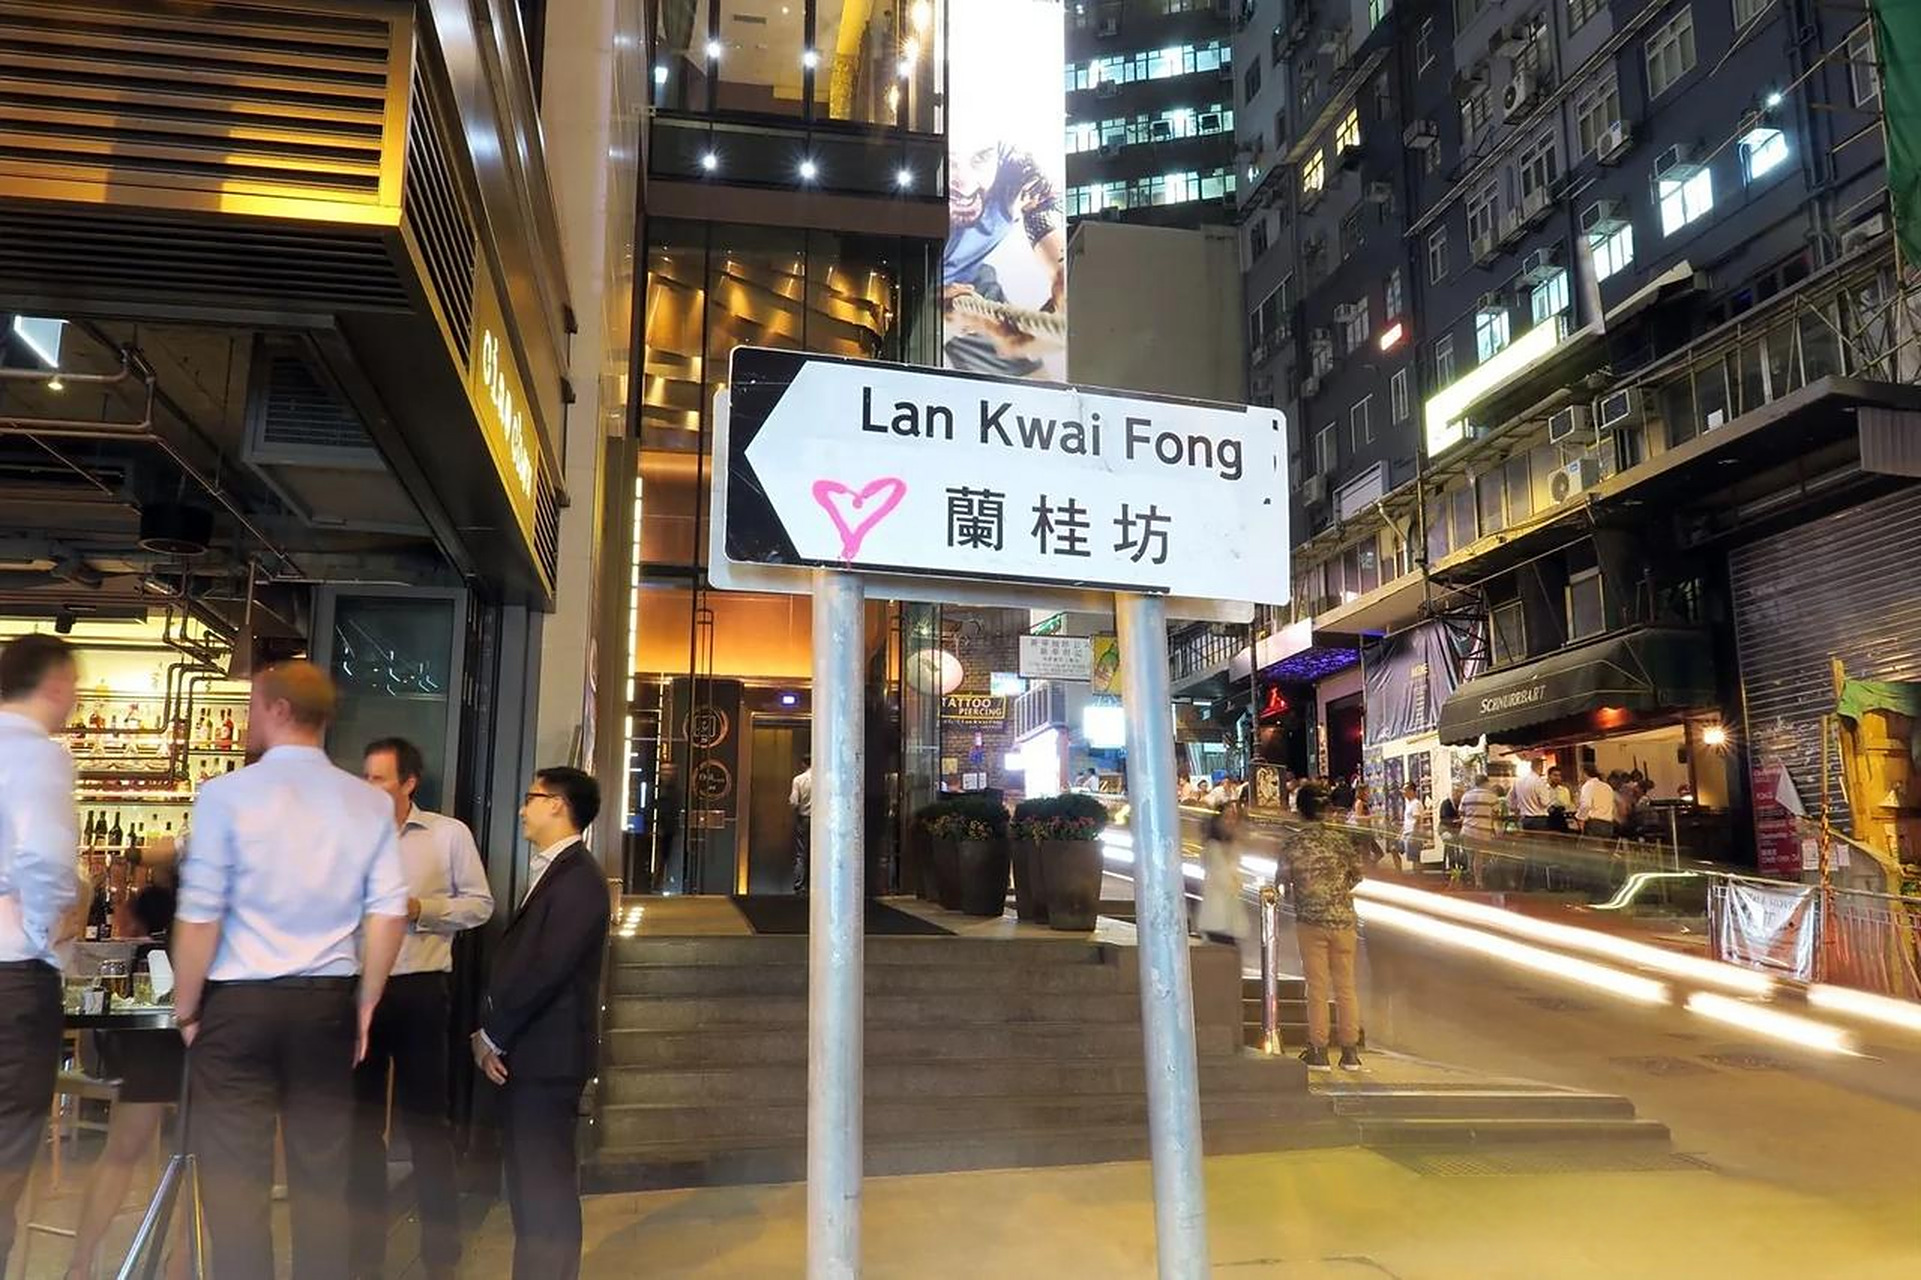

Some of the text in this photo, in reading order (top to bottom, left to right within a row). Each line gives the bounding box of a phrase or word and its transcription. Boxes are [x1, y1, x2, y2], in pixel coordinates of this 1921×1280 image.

[861, 386, 1243, 481] Lan Kwai Fong
[945, 485, 1172, 566] 蘭桂坊
[941, 697, 991, 709] TATTOO
[958, 707, 1002, 717] PIERCING
